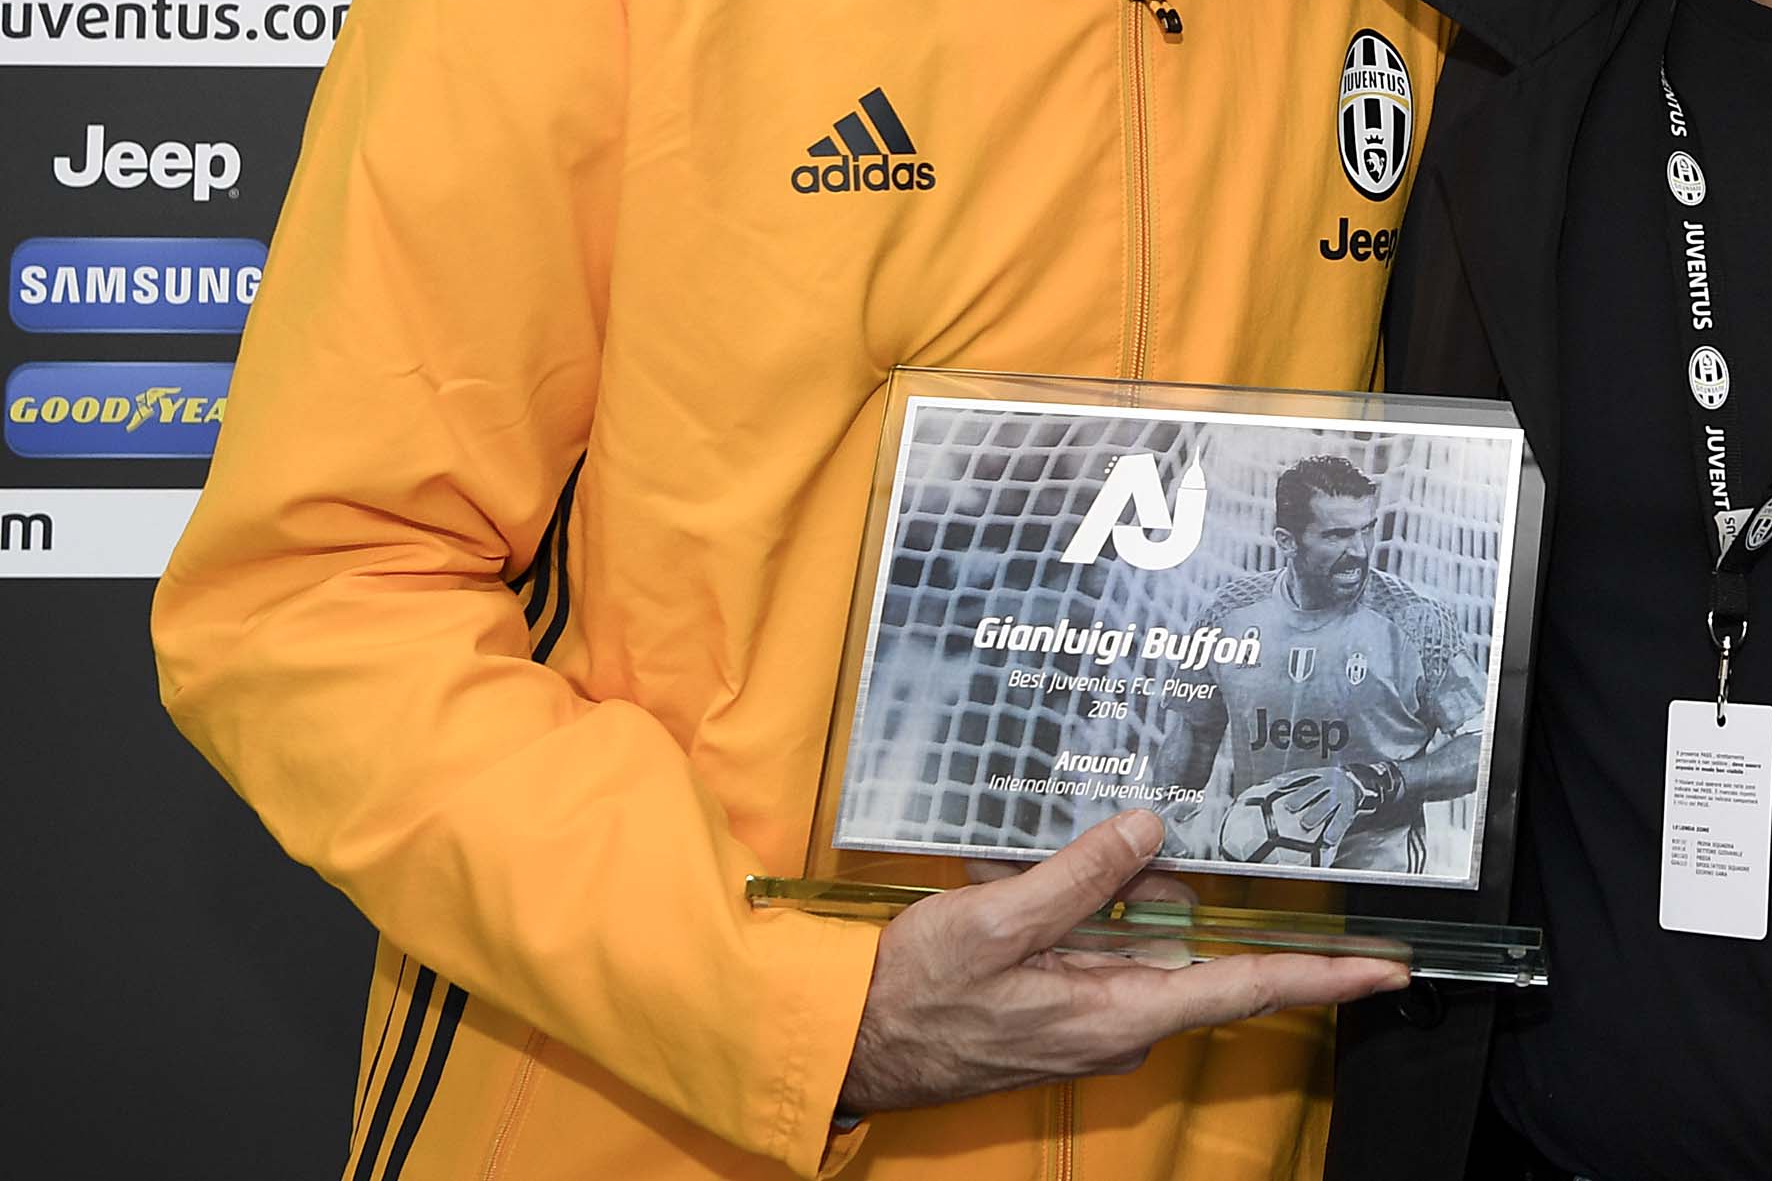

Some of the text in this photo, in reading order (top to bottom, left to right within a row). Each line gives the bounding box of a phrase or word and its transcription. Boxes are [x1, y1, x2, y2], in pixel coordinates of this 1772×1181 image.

[1343, 69, 1407, 97] JUVENTUS
[53, 124, 241, 201] Jeep
[791, 153, 936, 194] adidas
[1683, 220, 1713, 330] JUVENTUS
[1705, 425, 1731, 511] JUVENT
[973, 616, 1262, 671] Gianluigi Buffon
[1008, 670, 1046, 689] Best
[1047, 673, 1126, 694] Juventus
[1161, 678, 1218, 703] Player
[1087, 700, 1129, 720] 2016
[1250, 707, 1350, 759] Jeep
[1054, 751, 1149, 781] Around J
[988, 774, 1205, 804] International Juventus Fans
